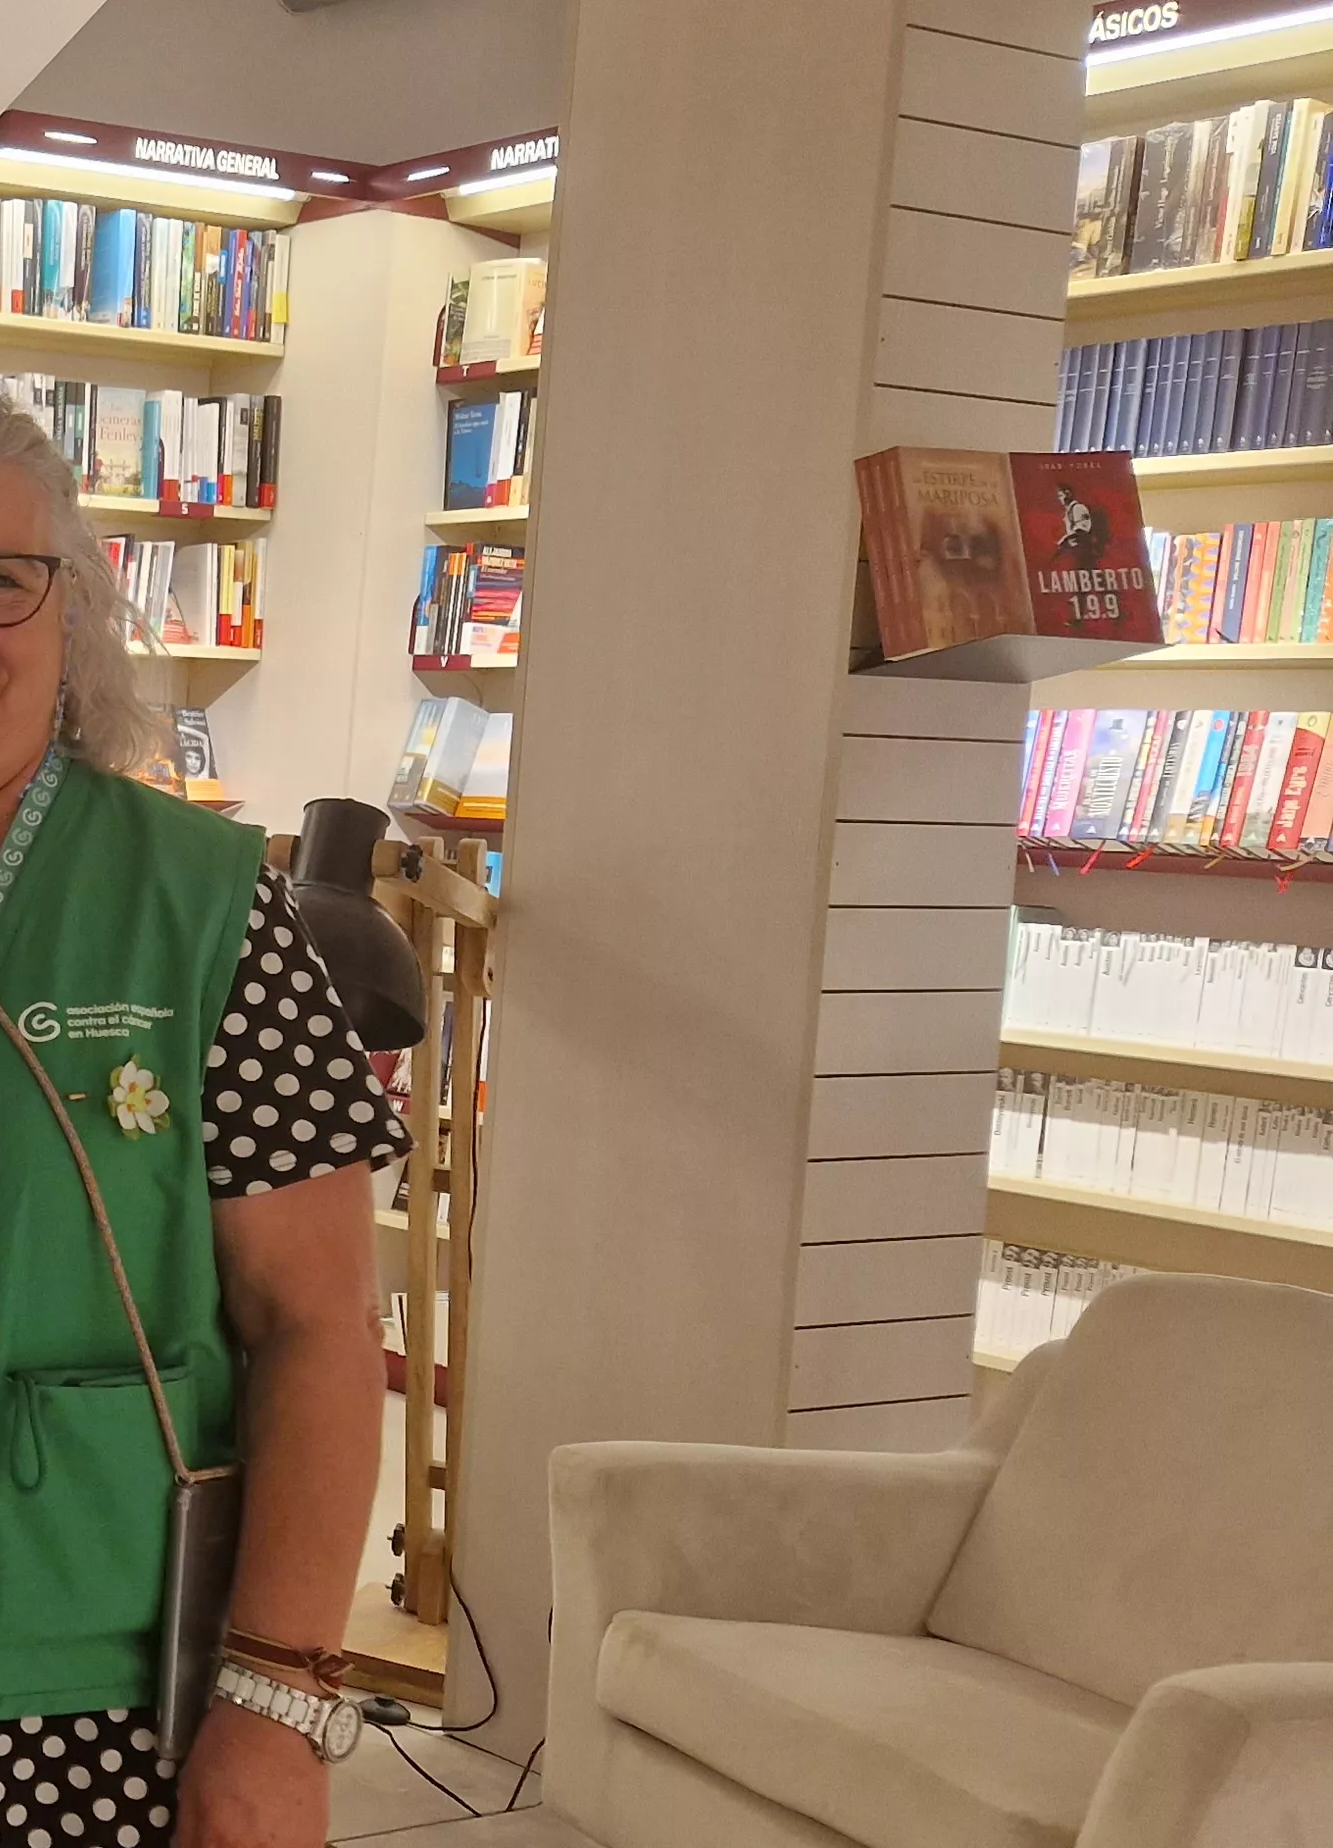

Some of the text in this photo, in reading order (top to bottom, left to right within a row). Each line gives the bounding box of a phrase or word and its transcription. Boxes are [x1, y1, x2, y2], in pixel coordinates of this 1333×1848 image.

[135, 137, 280, 180] NARRATIVA GENERAL
[462, 365, 469, 376] T
[180, 503, 189, 515] S
[1038, 567, 1144, 593] LAMBERTO
[440, 657, 448, 668] V
[1052, 748, 1079, 811] MUJERCITAS
[1087, 756, 1125, 816] MONTECRISTO
[1275, 765, 1307, 828] Jane Eyre
[66, 1002, 174, 1018] asociación española
[67, 1014, 152, 1030] contra el cáncer
[68, 1028, 130, 1039] en Huesca
[1002, 1266, 1014, 1291] Proust
[1041, 1271, 1052, 1297] Proust
